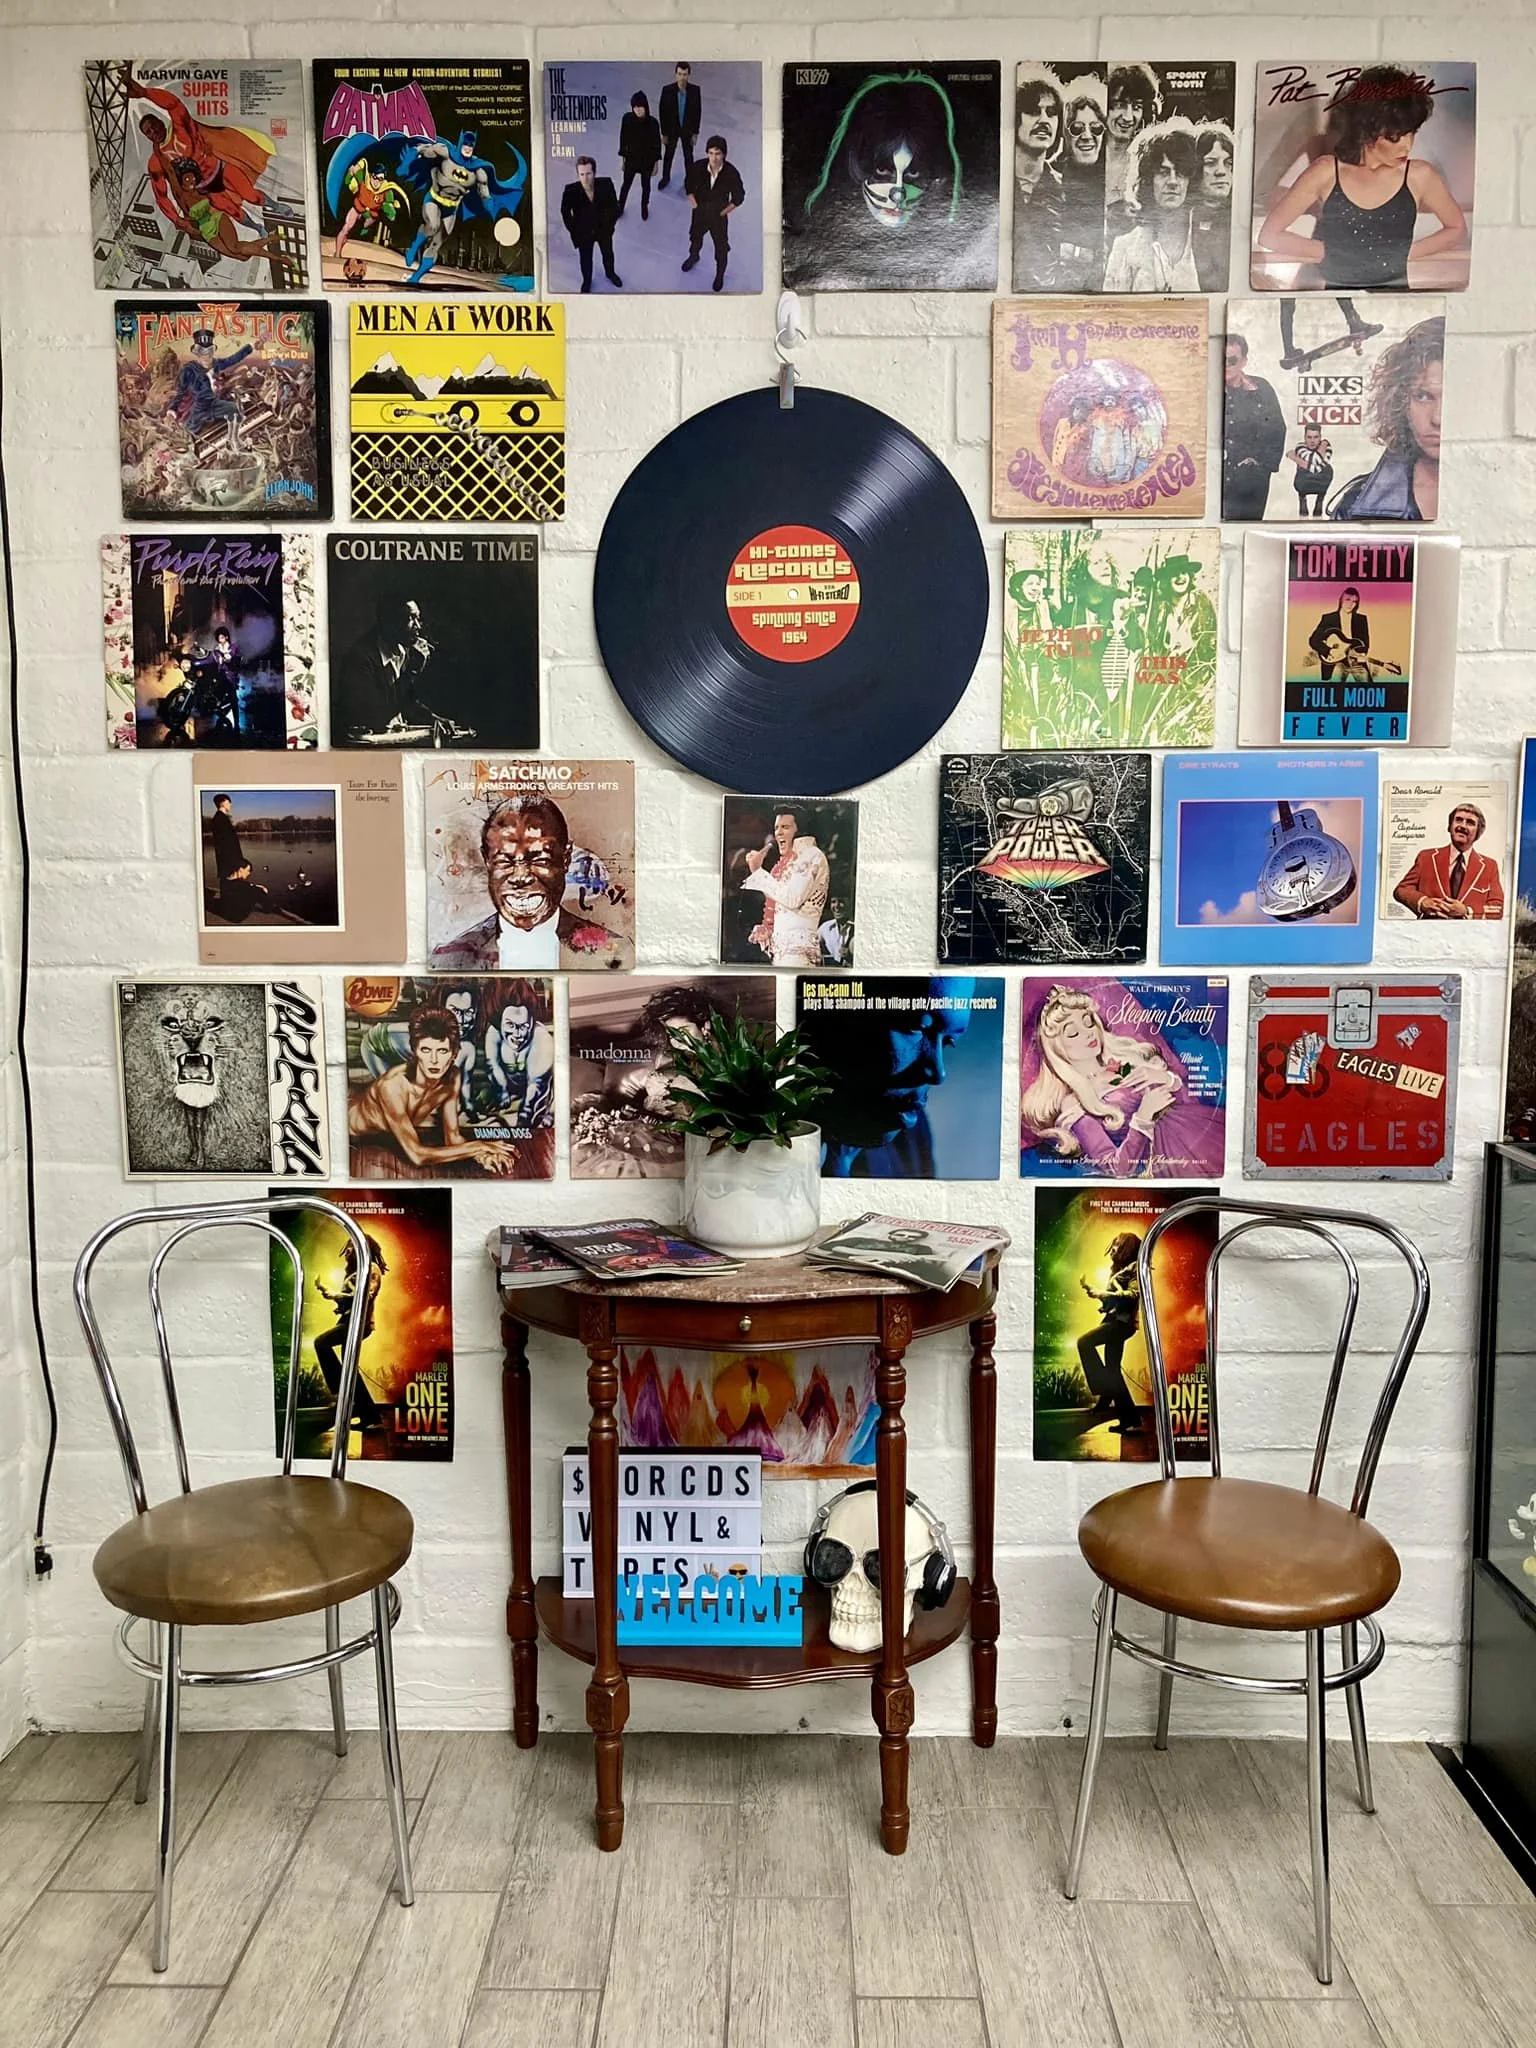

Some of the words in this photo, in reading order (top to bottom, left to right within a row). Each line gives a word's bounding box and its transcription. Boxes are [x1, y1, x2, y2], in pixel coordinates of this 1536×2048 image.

[137, 69, 190, 81] MARVIN
[194, 69, 228, 81] GAYE
[353, 68, 380, 78] EXCITING
[548, 68, 566, 94] THE
[796, 69, 829, 85] KISS
[1166, 71, 1207, 80] SPOOKY
[183, 82, 229, 97] SUPER
[1170, 80, 1204, 89] TOOTH
[1265, 66, 1329, 106] Pat
[197, 100, 229, 116] HITS
[325, 82, 435, 143] BATMAN
[550, 95, 608, 120] PRETENDERS
[551, 122, 587, 133] LEARNING
[551, 134, 561, 145] TO
[551, 146, 576, 158] CRAWL
[358, 304, 417, 331] MEN
[425, 304, 460, 331] AT
[468, 304, 554, 331] WORK
[136, 309, 302, 372] FANTASTIC
[1299, 377, 1362, 394] INXS
[1299, 407, 1361, 424] KICK
[371, 456, 450, 471] BUSINESS
[372, 473, 393, 488] AS
[401, 473, 450, 488] USUAL
[290, 479, 315, 502] JOHN
[335, 540, 464, 561] COLTRANE
[471, 540, 534, 561] TIME
[134, 537, 221, 584] Purple
[219, 542, 279, 586] Rain
[1294, 545, 1336, 578] TOM
[1346, 545, 1409, 578] PETTY
[733, 591, 754, 602] SIDE
[758, 591, 762, 602] 1
[825, 583, 850, 600] STEREO
[782, 631, 808, 644] 1964
[1018, 630, 1104, 644] JETHRO
[1045, 644, 1093, 658] TULL
[1141, 656, 1188, 670] THIS
[1136, 672, 1181, 685] WAS
[1303, 688, 1337, 708] FULL
[1343, 688, 1386, 708] MOON
[1292, 716, 1399, 737] FEVER
[488, 767, 572, 780] SATCHMO
[448, 782, 475, 790] LOUIS
[478, 782, 545, 790] ARMSTRONG'S
[548, 782, 596, 790] GREATEST
[598, 782, 618, 790] HITS
[1391, 786, 1412, 794] Dear
[1008, 816, 1085, 836] TOWER
[1036, 828, 1053, 839] OF
[975, 836, 1110, 868] POWER
[349, 978, 394, 1004] BOWIE
[803, 982, 816, 998] les
[851, 982, 865, 998] ltd.
[1129, 985, 1150, 993] WALT
[803, 998, 822, 1010] plays
[823, 998, 834, 1010] the
[835, 998, 865, 1010] shampoo
[866, 998, 874, 1010] at
[875, 998, 886, 1010] the
[887, 998, 910, 1010] village
[953, 998, 968, 1010] jazz
[969, 998, 996, 1010] records
[1106, 993, 1167, 1036] Sleeping
[1166, 997, 1224, 1036] Beauty
[580, 1042, 651, 1060] madonna
[1336, 1052, 1397, 1082] EAGLES
[1402, 1070, 1440, 1093] LIVE
[474, 1128, 511, 1139] DIAMOND
[511, 1128, 532, 1139] DOGS
[1266, 1120, 1439, 1153] EAGLES
[432, 1362, 448, 1372] BOB
[1195, 1363, 1206, 1372] BO
[416, 1372, 448, 1382] MARLEY
[1178, 1373, 1207, 1383] MARLE
[406, 1382, 448, 1407] ONE
[1168, 1384, 1208, 1409] ONE
[395, 1408, 448, 1433] LOVE
[1170, 1409, 1208, 1434] OVE
[717, 1511, 730, 1542] &
[616, 1574, 804, 1623] WELCOME
